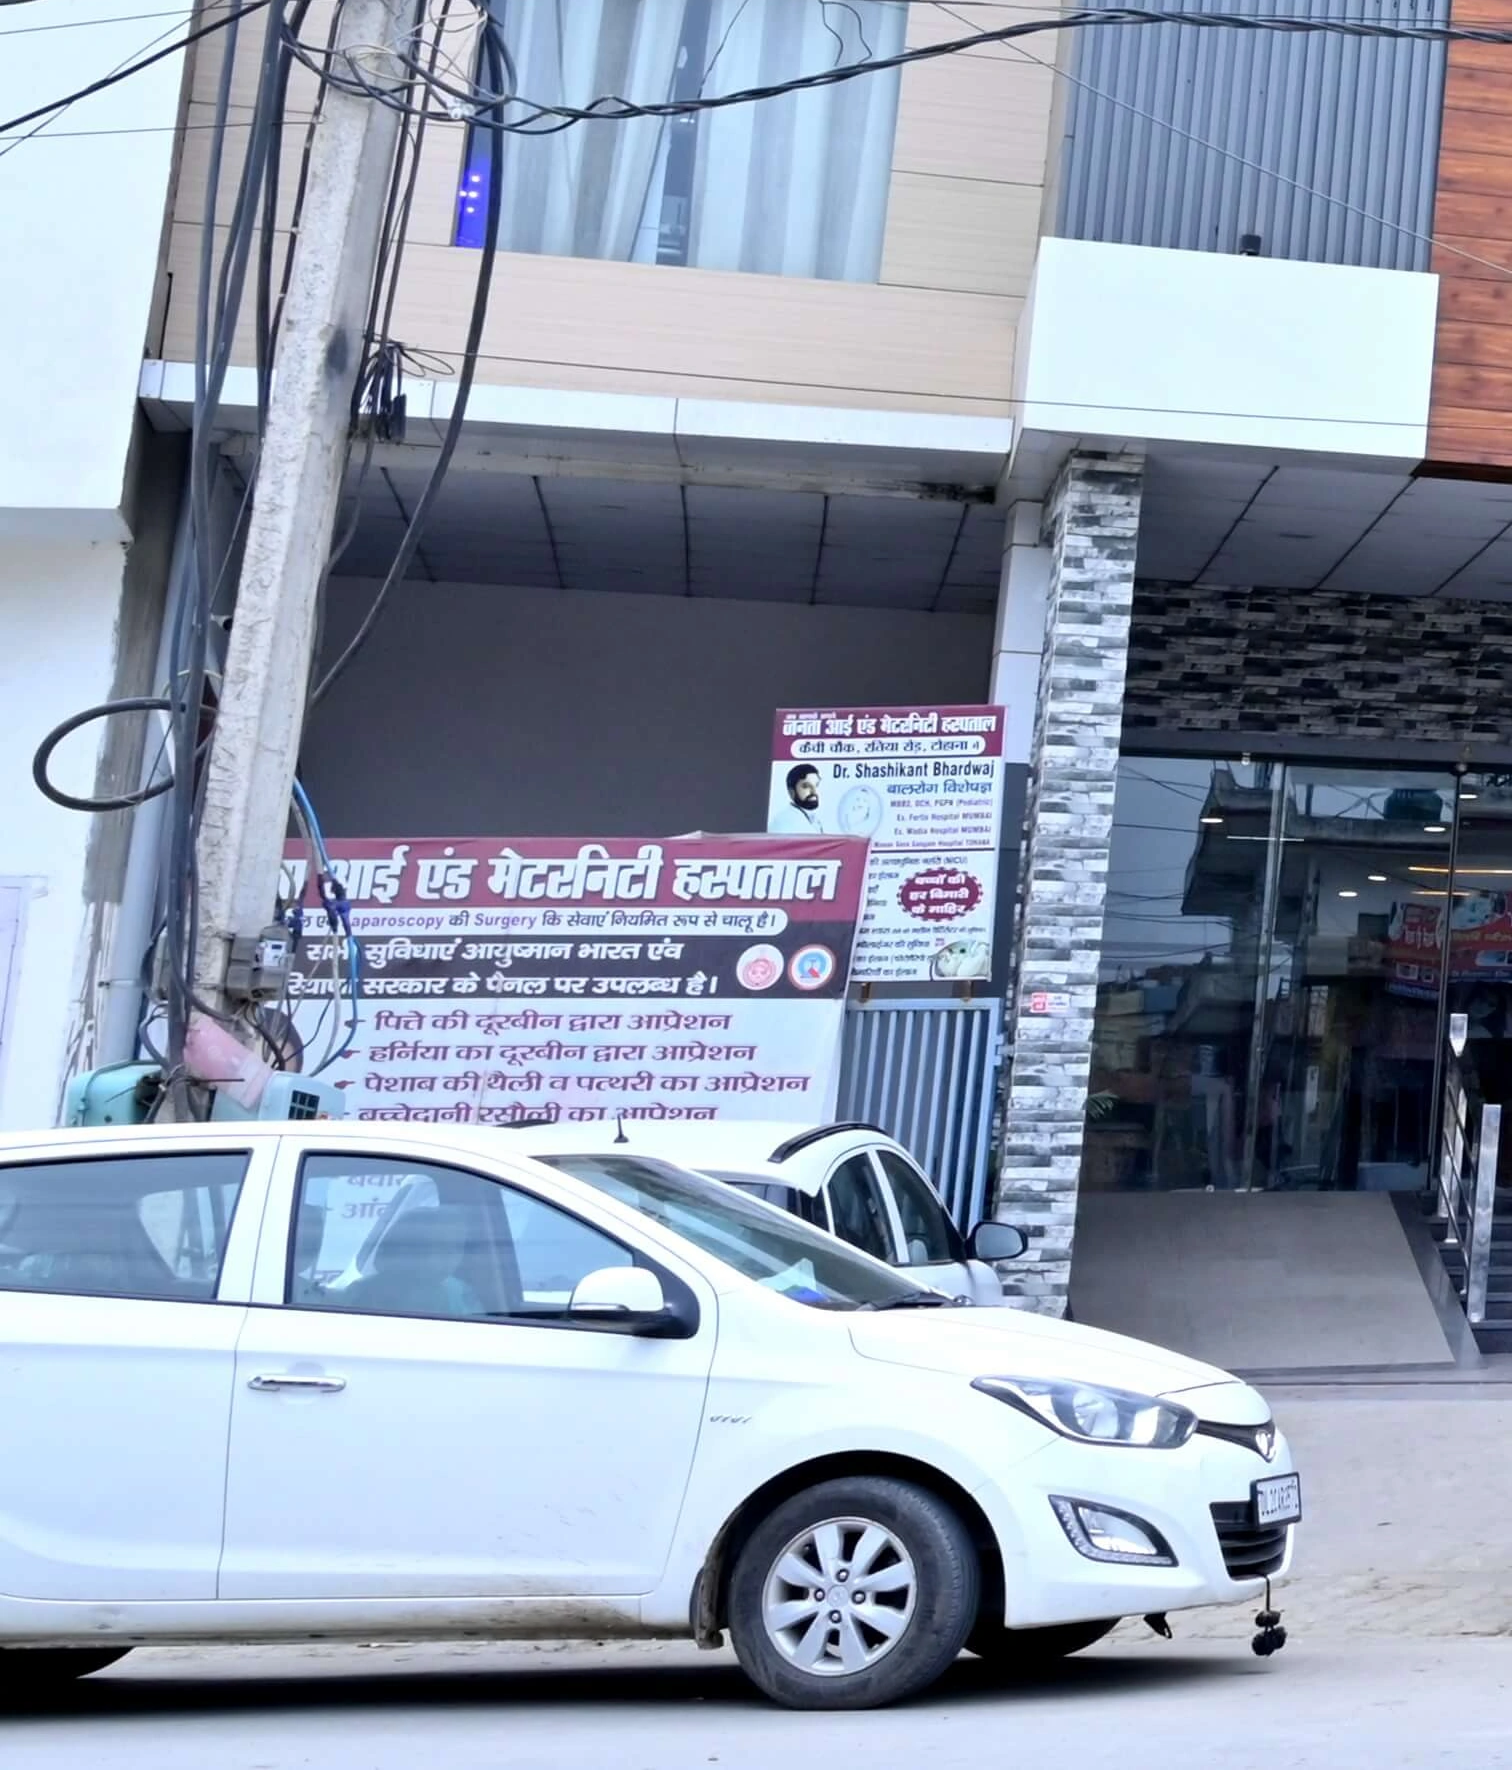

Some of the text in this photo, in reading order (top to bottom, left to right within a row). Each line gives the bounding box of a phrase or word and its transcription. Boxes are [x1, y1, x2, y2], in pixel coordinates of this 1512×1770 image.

[833, 759, 996, 780] Dr. Shashikant Bhardwaj
[365, 937, 685, 970] सुविधाएं आयुष्मान भारत एंव
[362, 970, 718, 997] सरकार के पैनल पर उपलब्ध है।
[375, 1010, 733, 1036] पित्ते की दूरबीन द्वारा आप्रेशन
[368, 1039, 759, 1066] हर्निया का दूरबीन द्वारा आप्रेशन
[364, 1070, 812, 1094] पेशाब की थैली व पत्थरी का आप्रेशन
